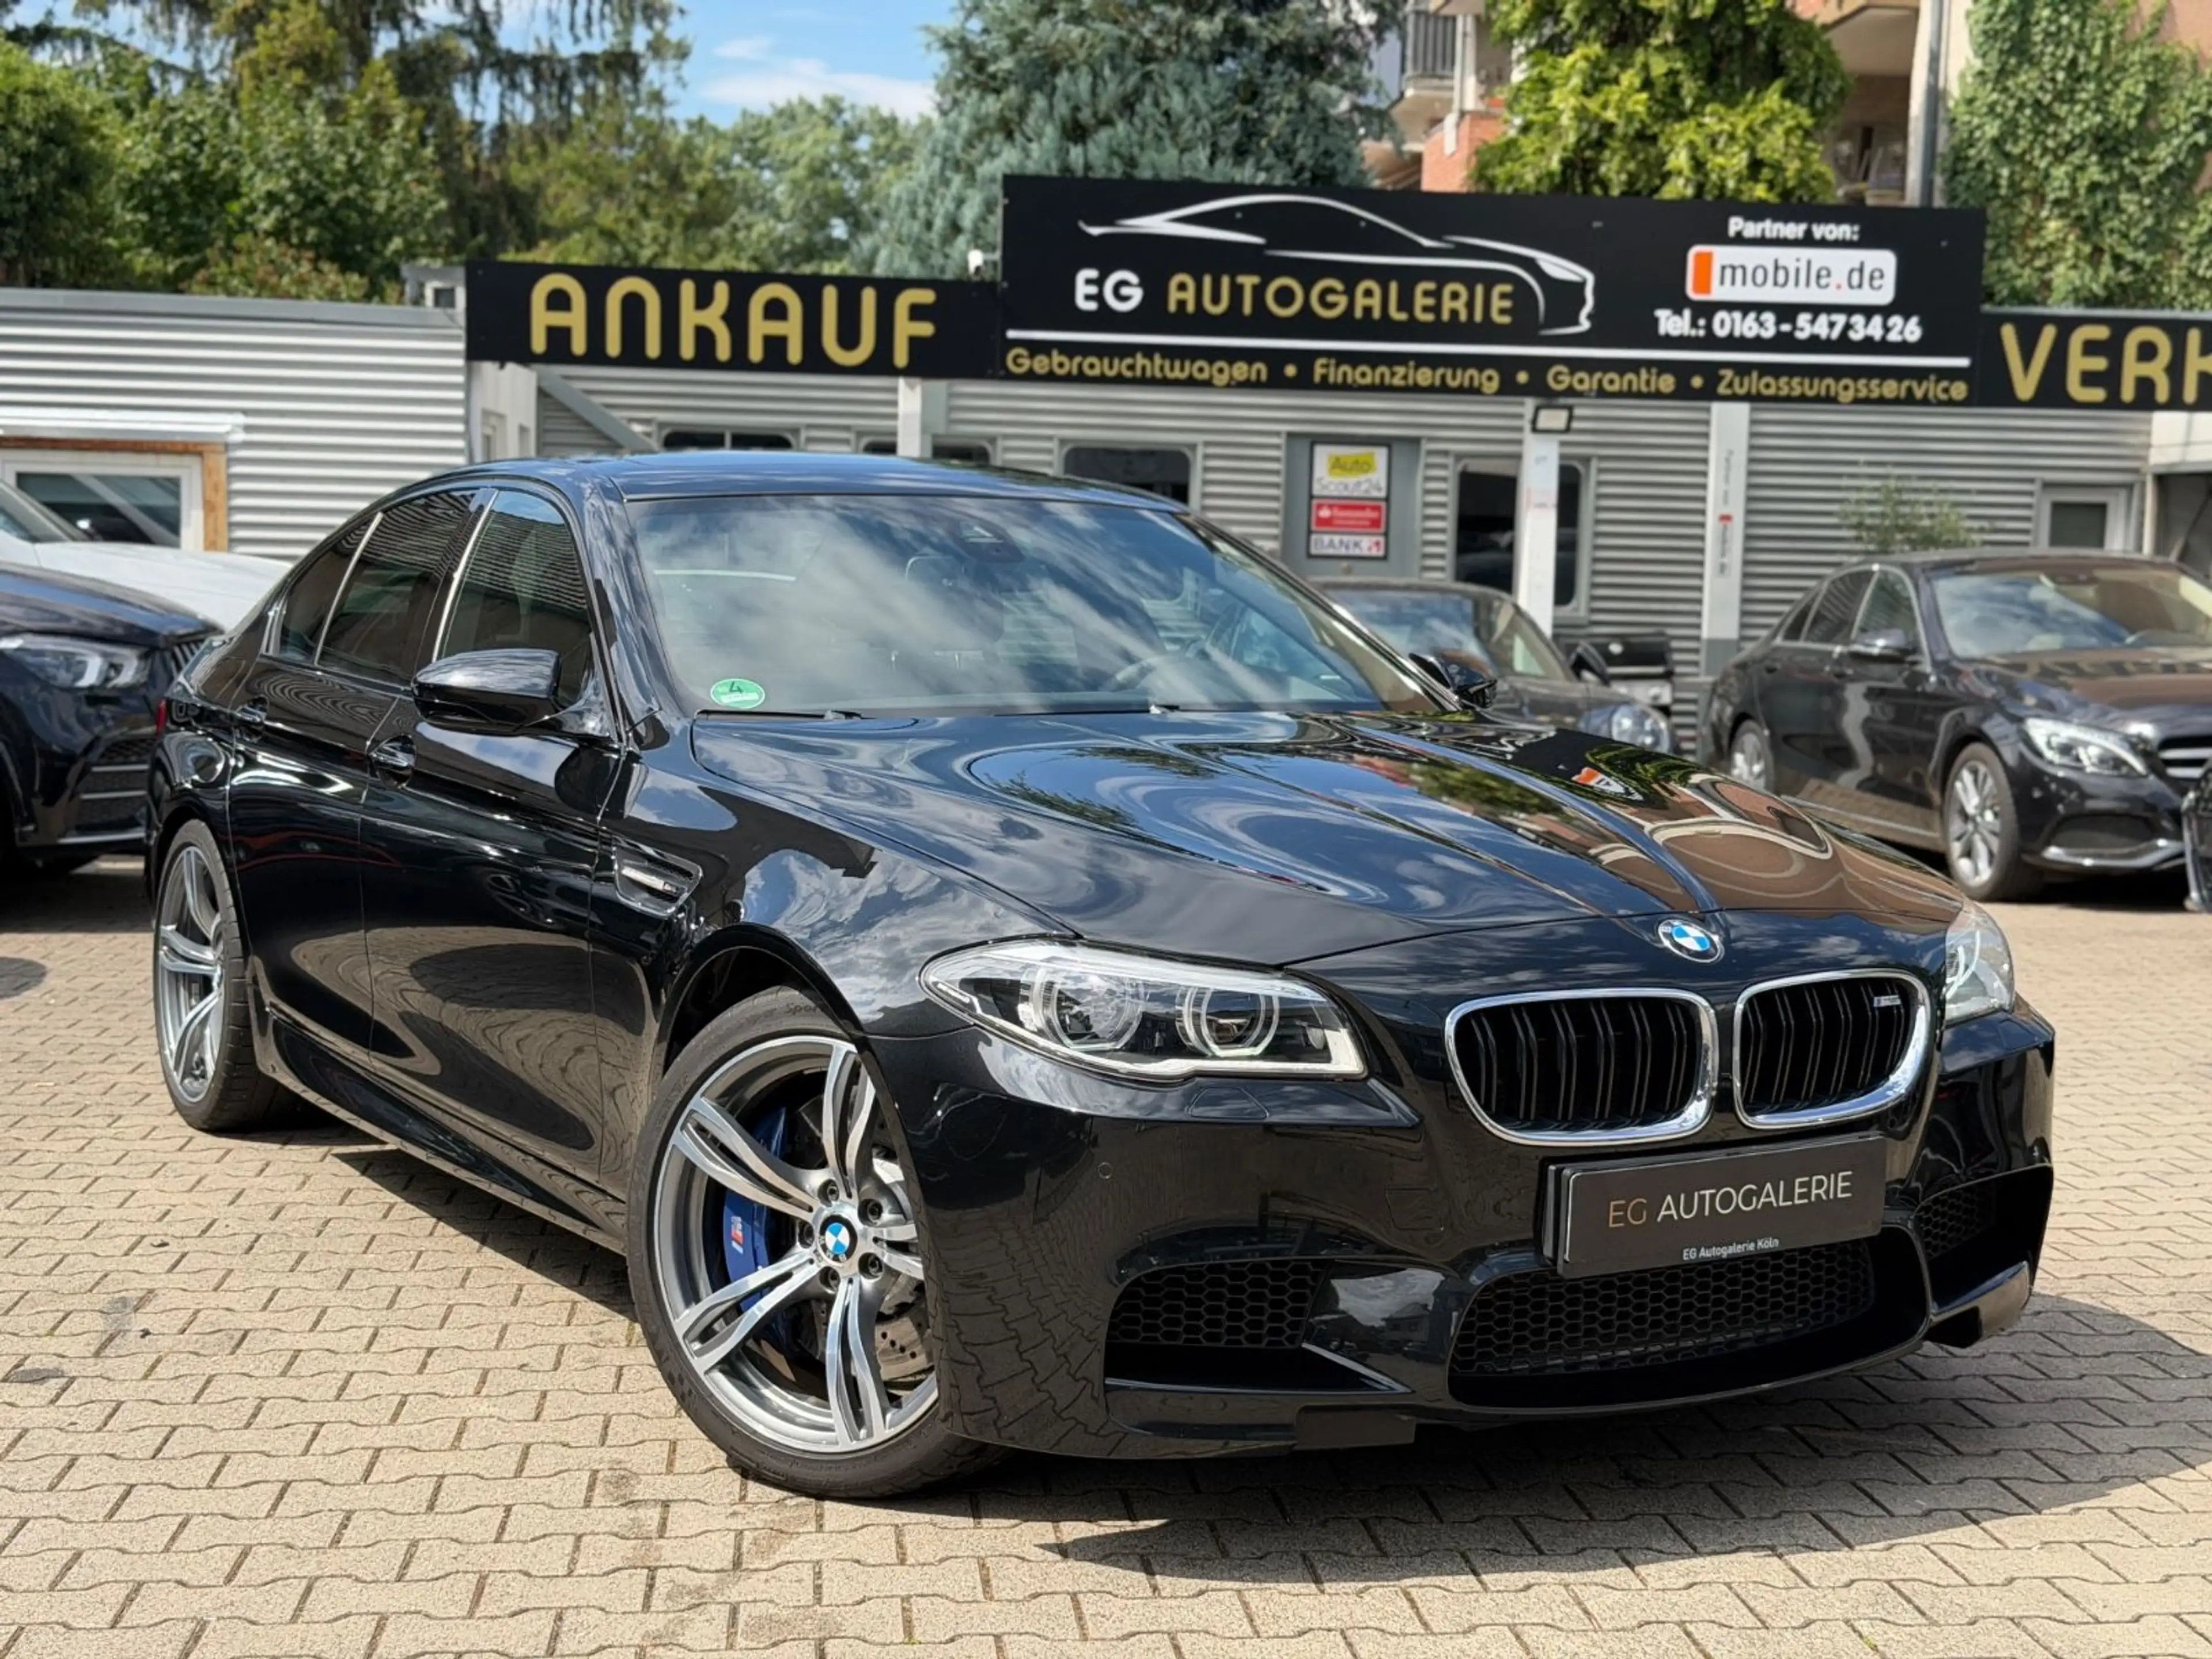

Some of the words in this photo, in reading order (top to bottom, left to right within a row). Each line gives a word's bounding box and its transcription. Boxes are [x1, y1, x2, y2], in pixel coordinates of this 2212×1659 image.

[1728, 215, 1808, 240] Partner
[1811, 222, 1859, 241] von:
[1074, 268, 1144, 312] EG
[1168, 272, 1513, 324] AUTOGALERIE
[1719, 258, 1885, 290] mobile.de
[531, 273, 936, 368] ANKAUF
[1653, 308, 1706, 337] Tel.:
[1005, 347, 1267, 387] Gebrauchtwagen
[1313, 358, 1500, 394] Finanzierung
[1547, 364, 1676, 394] Garantie
[1717, 368, 1969, 403] Zulassungsservice
[1609, 1198, 1647, 1228] EG
[1657, 1171, 1853, 1222] AUTOGALERIE
[1683, 1248, 1697, 1260] EG
[1699, 1240, 1755, 1258] Autogalerie
[1757, 1237, 1779, 1250] Köln
